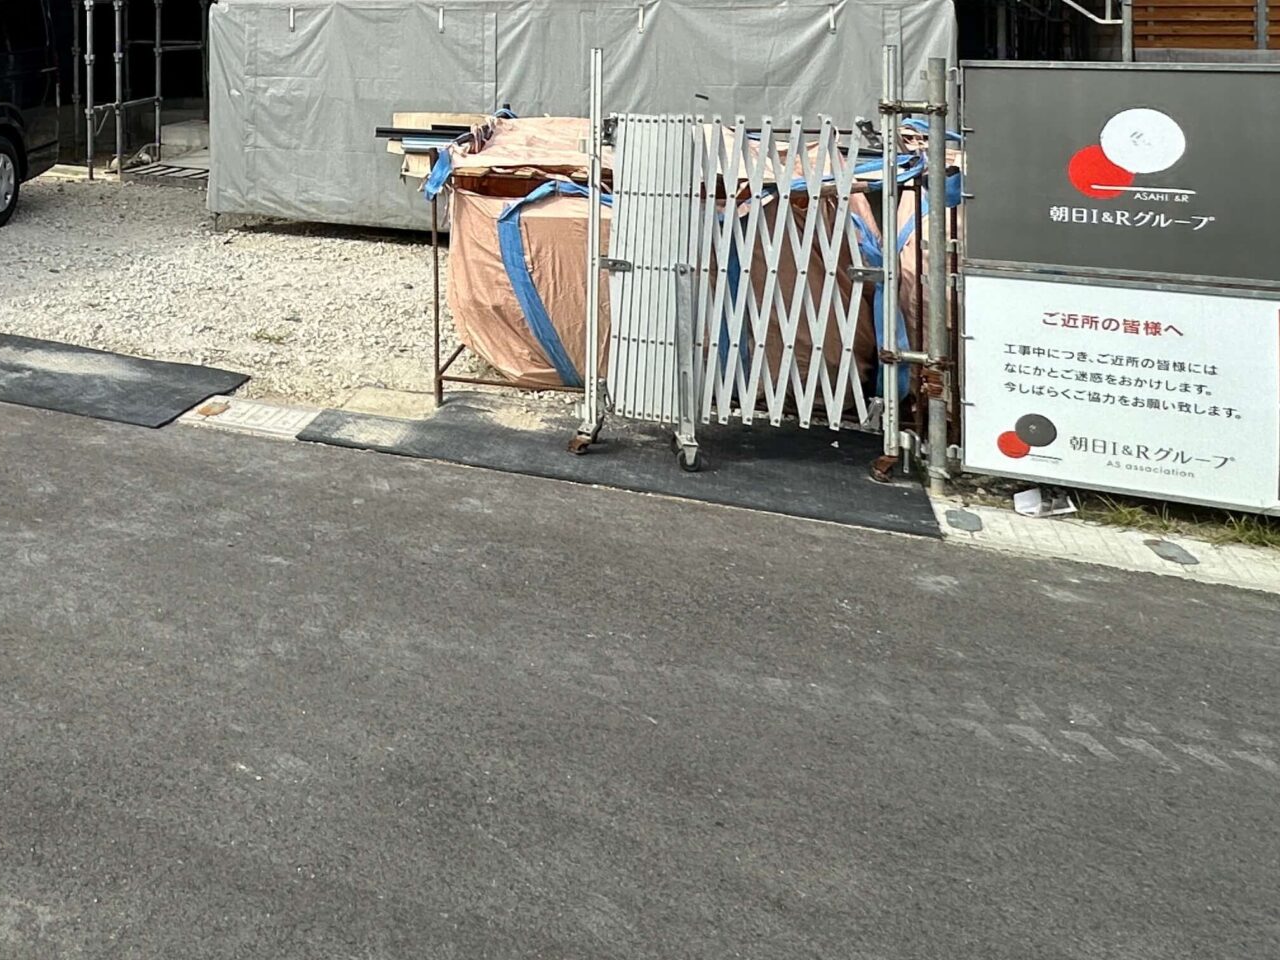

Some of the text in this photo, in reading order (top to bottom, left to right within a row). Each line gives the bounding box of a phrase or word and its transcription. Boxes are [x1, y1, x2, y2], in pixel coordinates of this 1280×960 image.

[1133, 192, 1169, 202] ASAHI
[1049, 206, 1216, 230] 朝日I&Rグループ
[1042, 311, 1184, 337] ご近所の皆様へ
[1003, 343, 1218, 376] 工事中につき、ご近所の皆様には
[1004, 362, 1212, 396] なにかとご迷惑をおかけします。
[1003, 380, 1242, 420] 今しばらくご協力をお願い致します。
[1069, 435, 1236, 469] 朝日I&Rグループ
[1125, 462, 1195, 478] association
